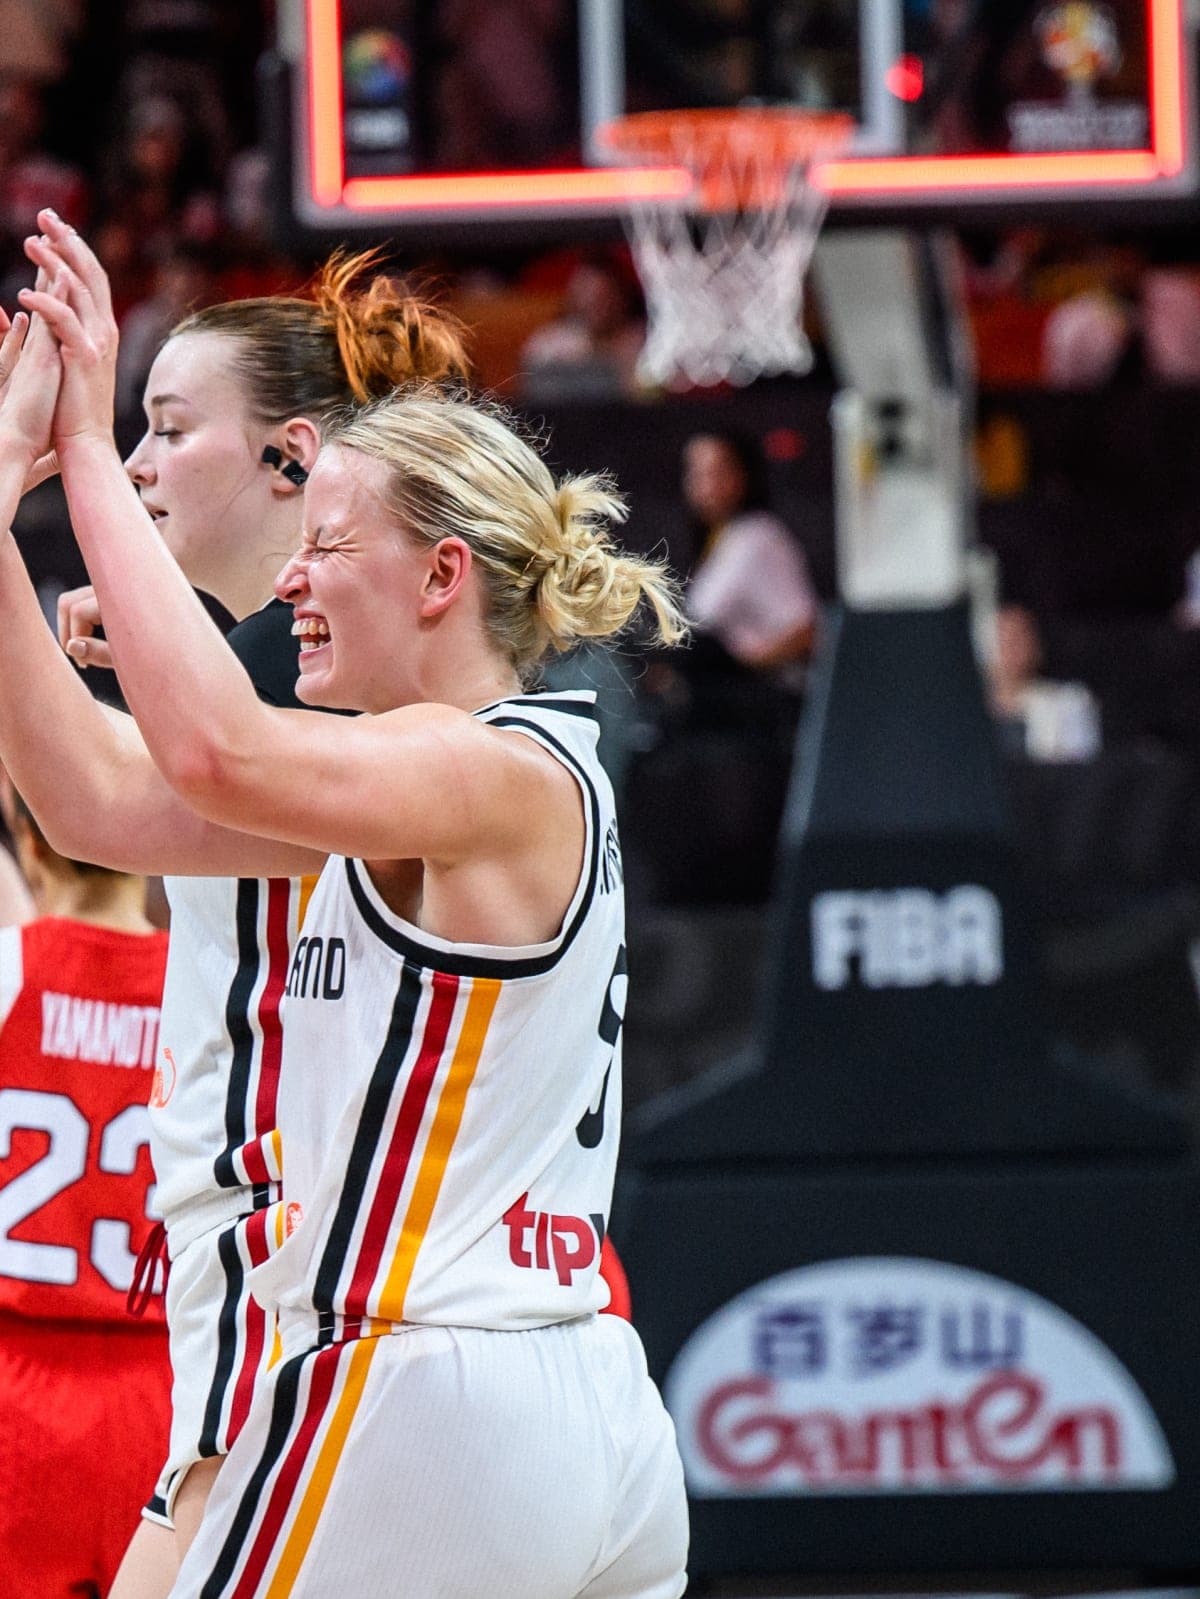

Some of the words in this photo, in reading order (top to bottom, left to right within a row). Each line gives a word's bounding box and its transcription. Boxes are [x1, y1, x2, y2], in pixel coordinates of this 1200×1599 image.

[810, 885, 1003, 989] FIBA
[752, 1301, 1026, 1378] 百岁山
